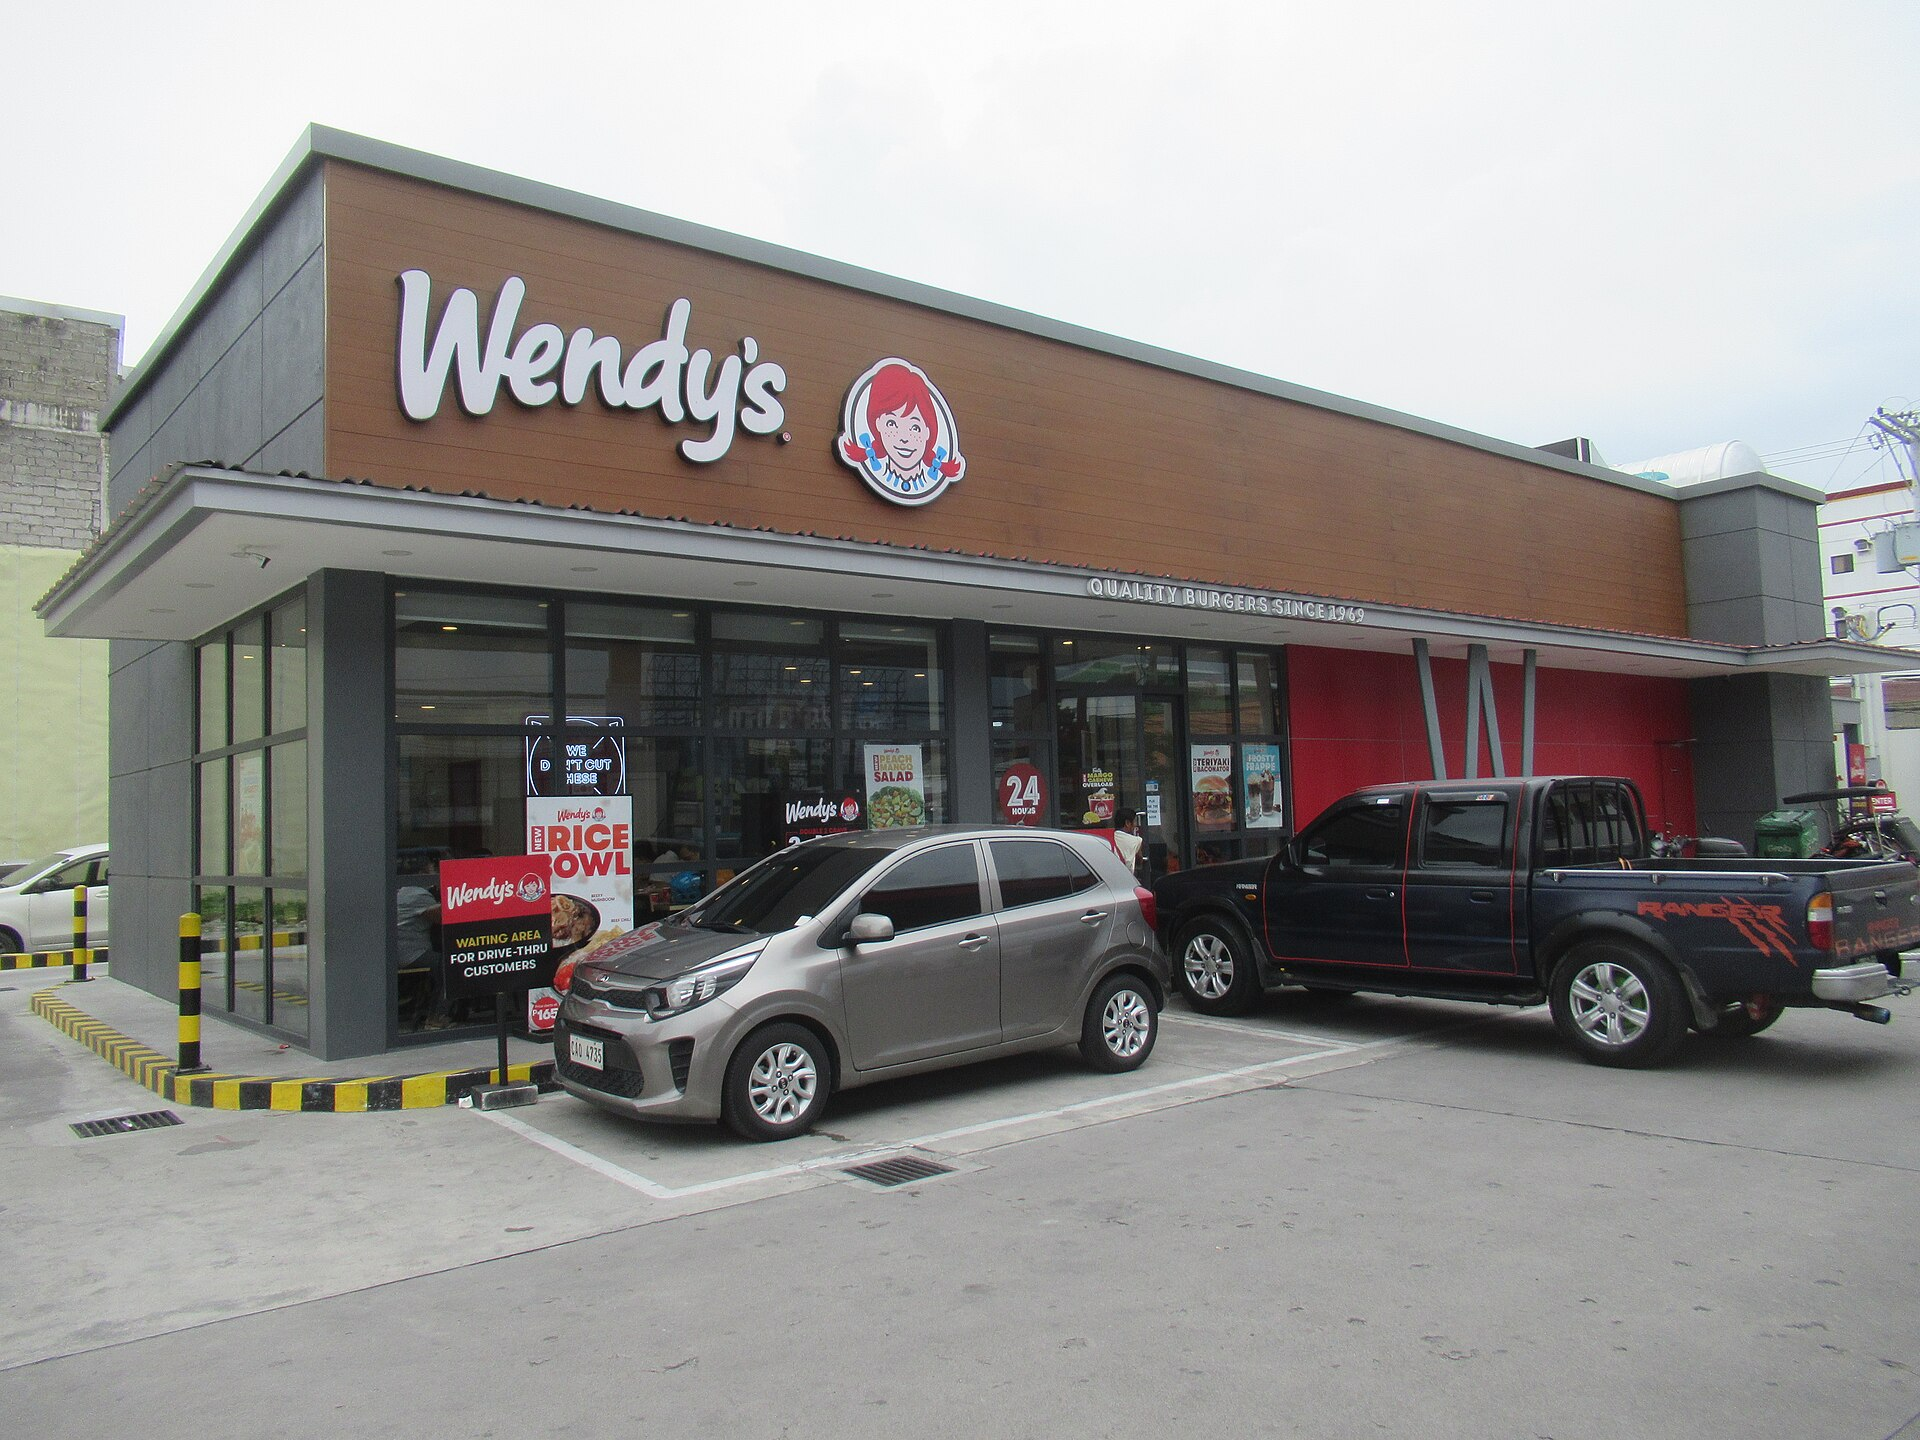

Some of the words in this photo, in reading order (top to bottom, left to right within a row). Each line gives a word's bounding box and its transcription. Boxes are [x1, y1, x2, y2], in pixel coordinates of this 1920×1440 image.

[399, 269, 787, 462] Wendy's
[1088, 578, 1177, 603] QUALITY
[1184, 588, 1268, 613] BURGERS
[1274, 599, 1325, 619] SINCE
[1331, 606, 1365, 623] 1969
[565, 745, 587, 757] WE
[880, 755, 912, 763] PEACH
[584, 759, 612, 771] CUT
[880, 763, 913, 771] MANGO
[1197, 758, 1230, 766] TERIYAKI
[566, 773, 598, 785] HESE
[874, 771, 913, 783] SALAD
[1006, 775, 1041, 807] 24
[1012, 806, 1036, 815] HOURS
[1872, 797, 1893, 805] ENTER
[557, 807, 591, 823] Wendy's
[786, 797, 837, 825] Wendy's
[534, 828, 542, 850] NEW
[547, 823, 629, 852] RICE
[446, 876, 515, 910] Wendy's
[1637, 901, 1787, 928] RANGER
[456, 934, 508, 949] WAITING
[511, 929, 542, 941] AREA
[450, 952, 475, 964] FOR
[478, 943, 548, 961] DRIVE-THRU
[463, 959, 537, 978] CUSTOMERS
